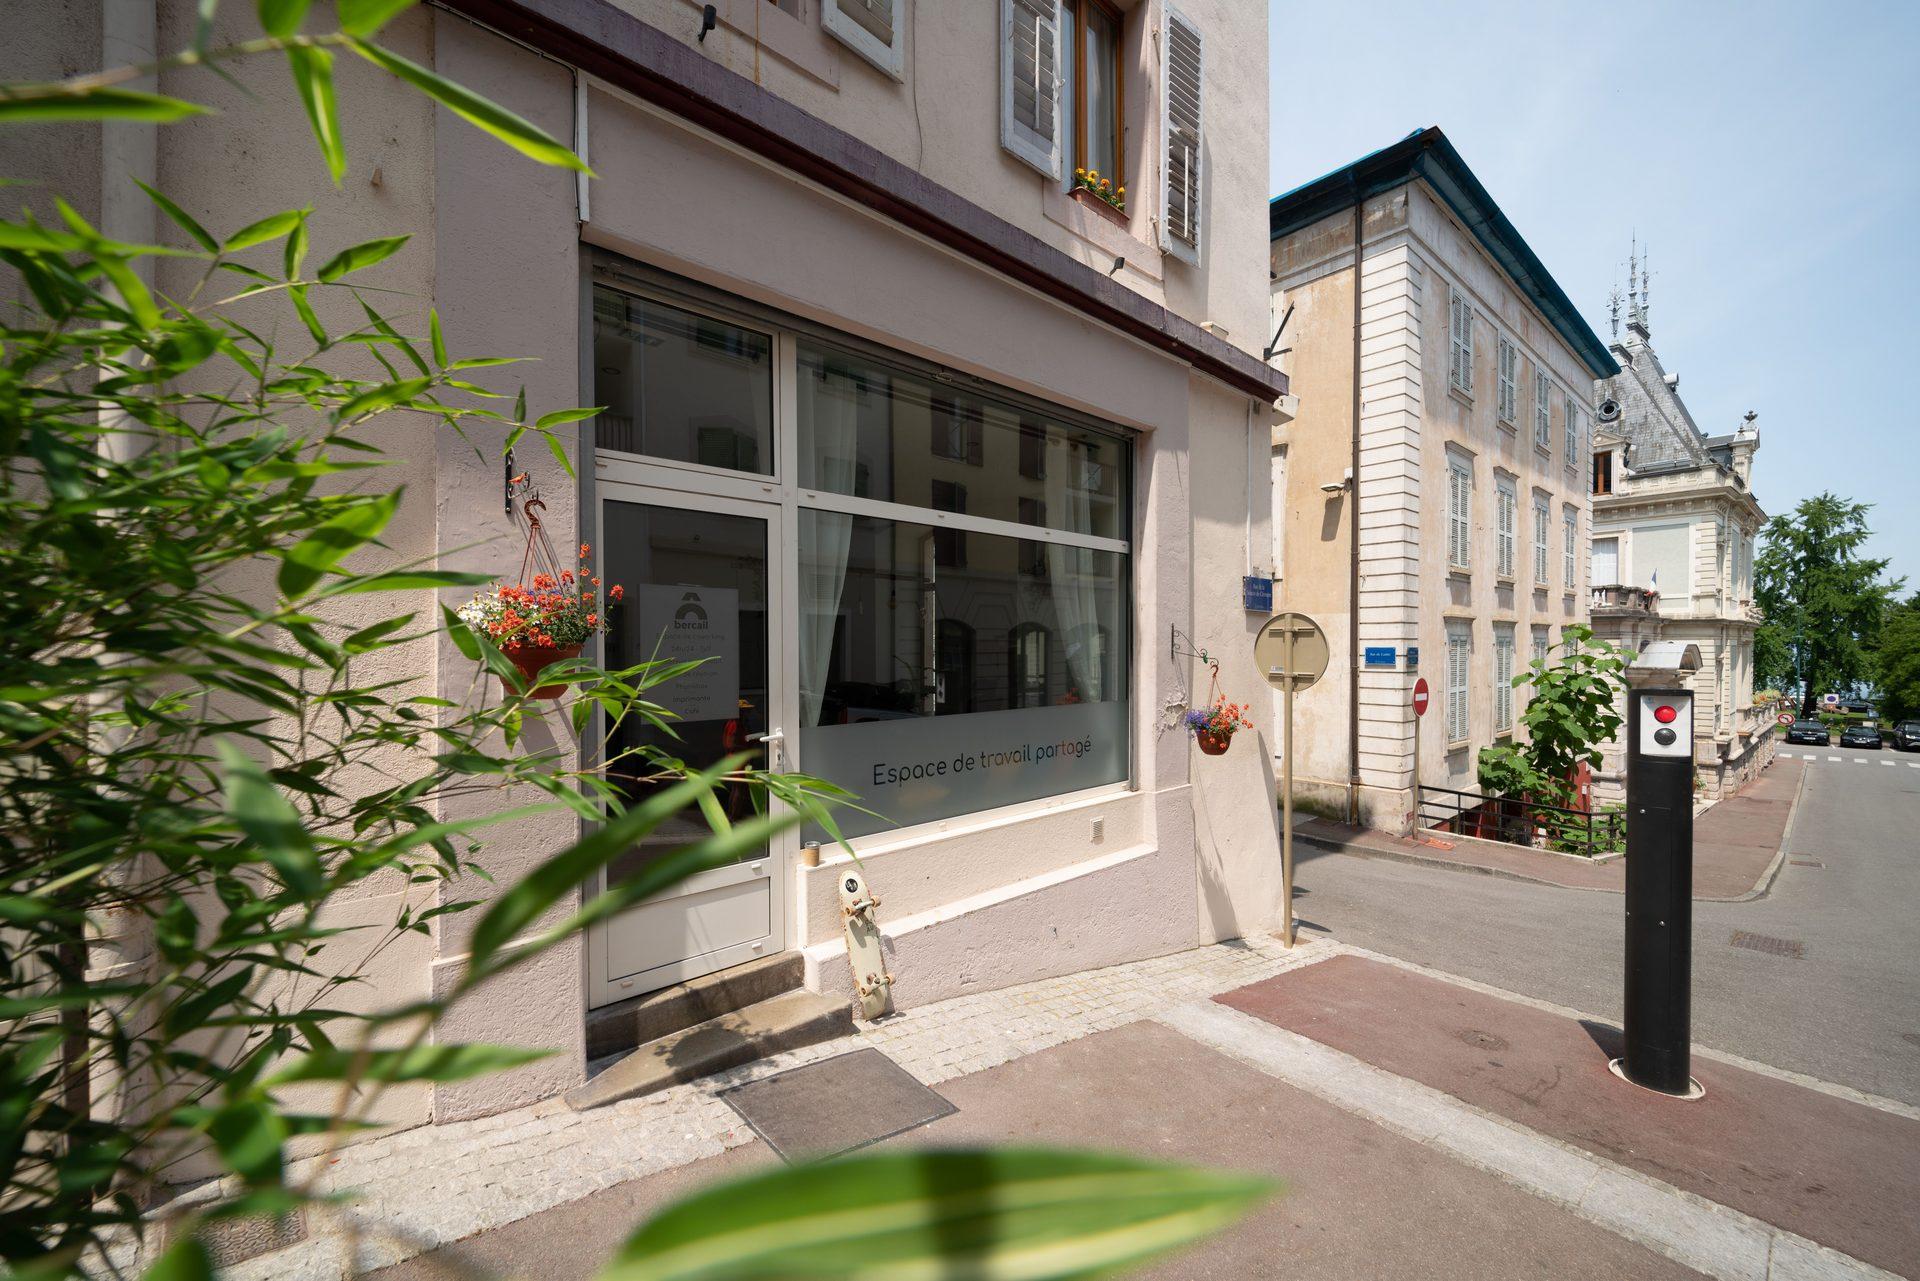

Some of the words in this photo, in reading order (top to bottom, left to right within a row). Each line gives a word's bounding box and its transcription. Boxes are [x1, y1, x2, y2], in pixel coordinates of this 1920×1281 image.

[674, 620, 709, 630] bercail
[873, 760, 947, 787] Espace
[953, 753, 975, 773] de
[980, 744, 1031, 769] travail
[1036, 735, 1092, 765] partagé
